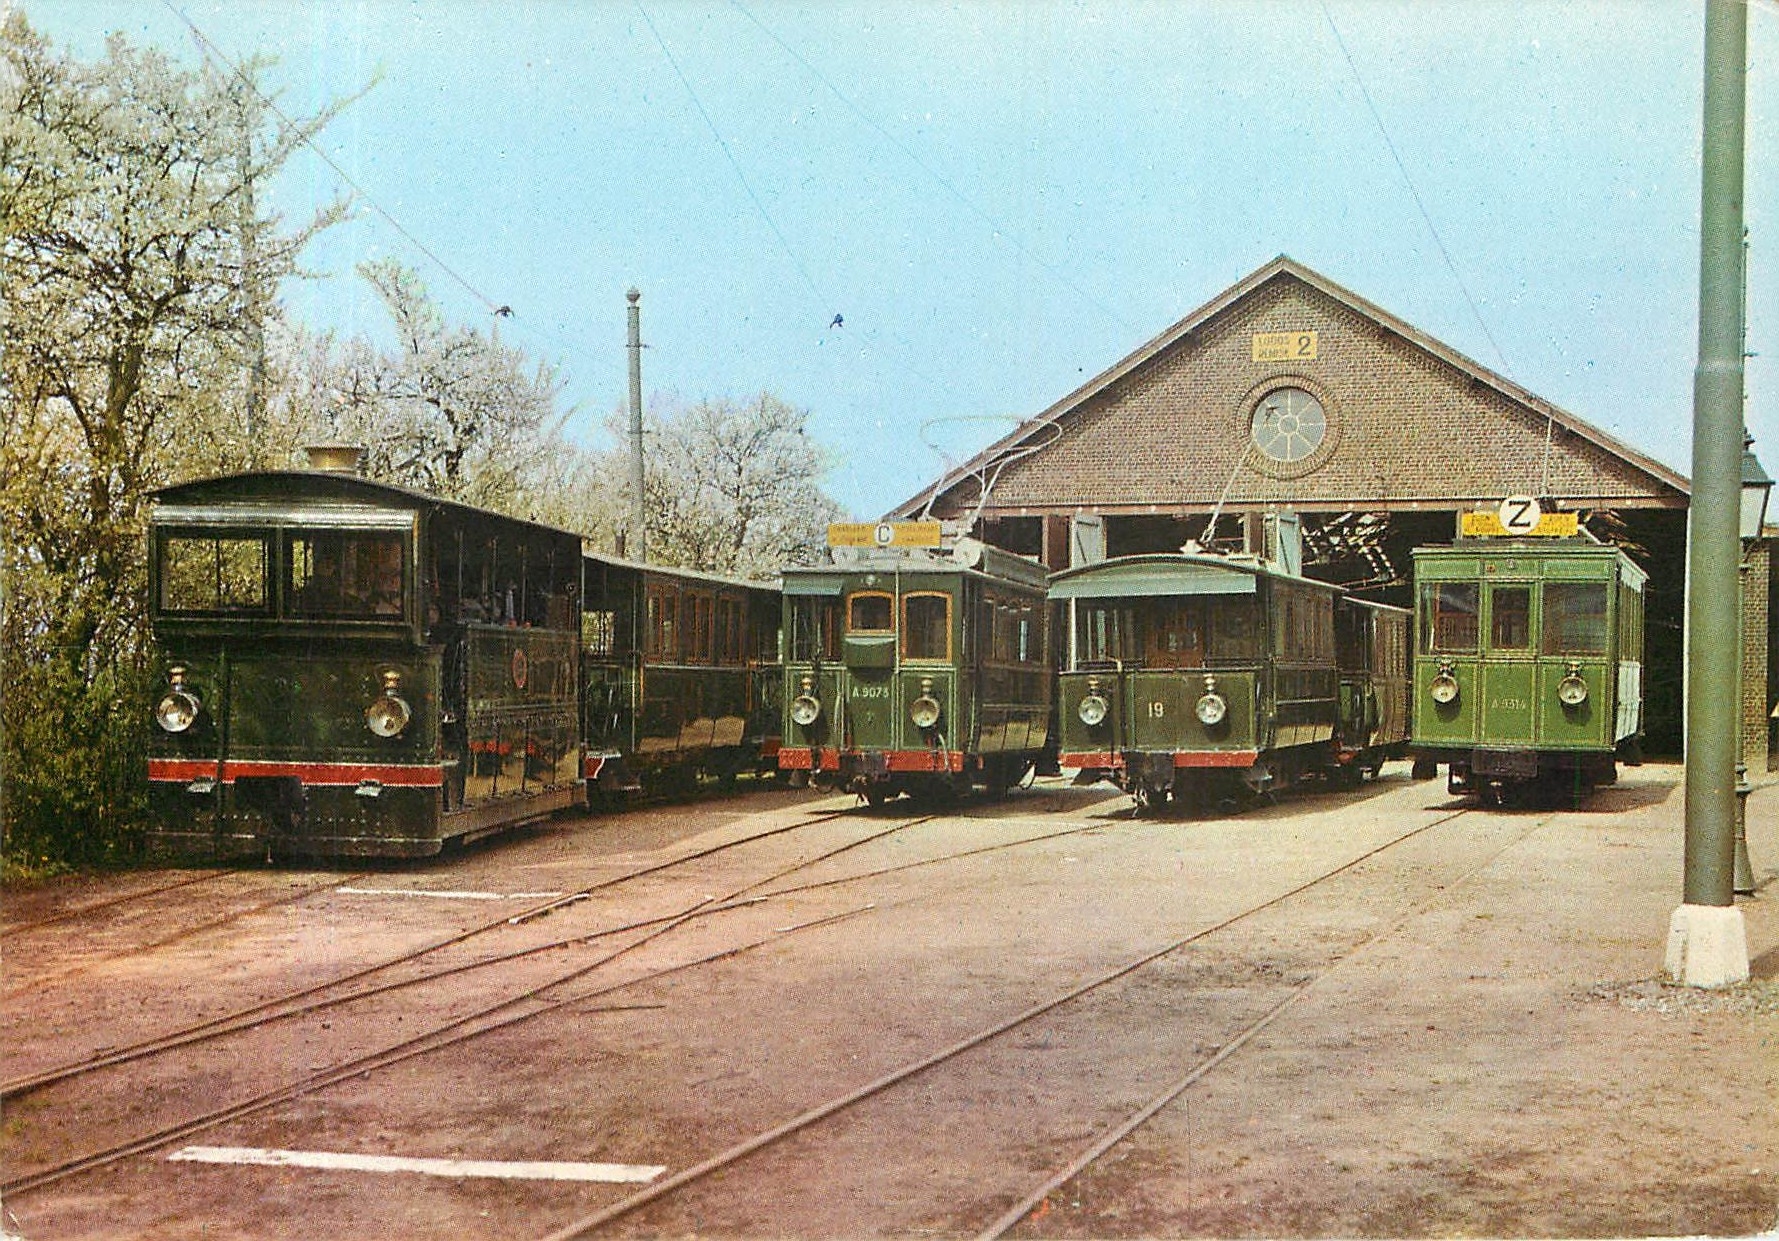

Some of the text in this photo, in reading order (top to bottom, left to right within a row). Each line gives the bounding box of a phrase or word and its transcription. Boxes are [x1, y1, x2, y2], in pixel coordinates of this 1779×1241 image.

[1298, 335, 1311, 356] 2
[1508, 500, 1531, 527] Z
[879, 525, 890, 543] C
[1148, 701, 1163, 718] 19
